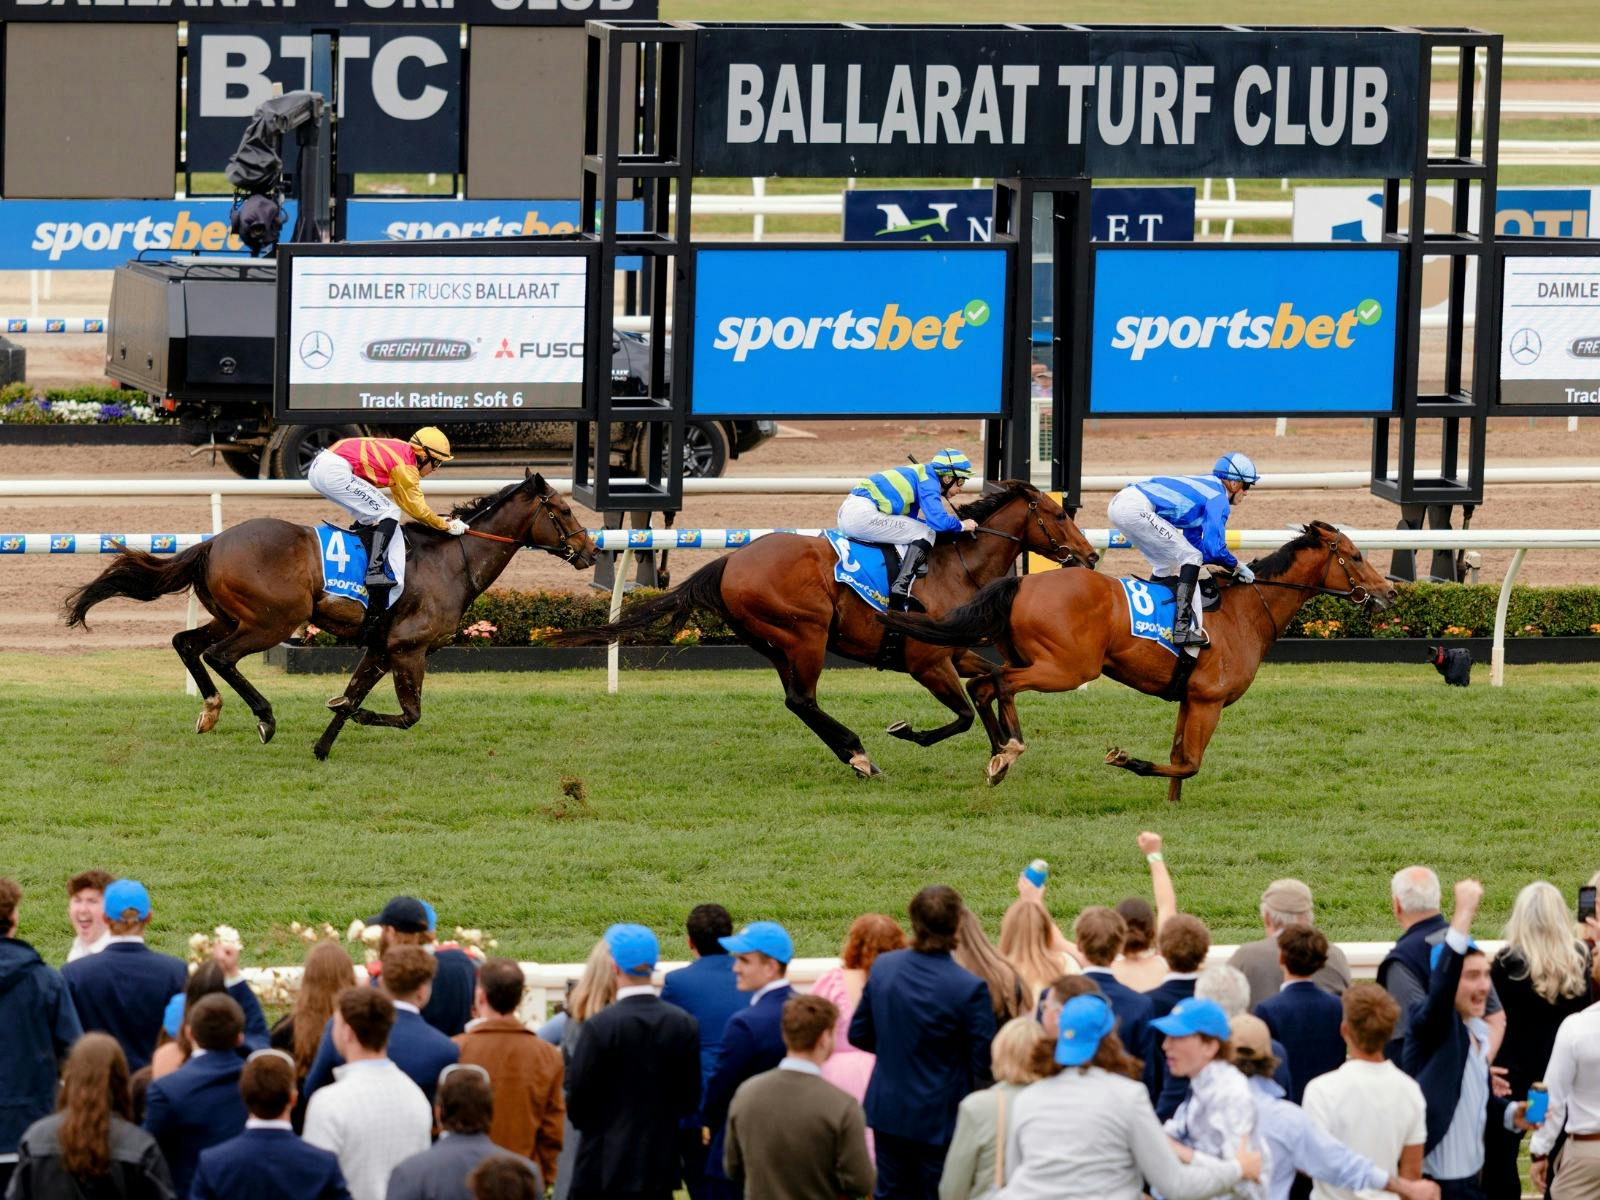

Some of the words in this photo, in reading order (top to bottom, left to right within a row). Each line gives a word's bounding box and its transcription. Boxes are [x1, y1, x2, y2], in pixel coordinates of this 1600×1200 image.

[200, 35, 448, 121] BTC
[727, 63, 1040, 145] BALLARAT
[1058, 65, 1215, 146] TURF
[1234, 64, 1389, 146] CLUB
[386, 211, 580, 241] sportsb
[328, 283, 406, 300] DAIMLER
[408, 283, 473, 300] TRUCKS
[475, 283, 561, 300] BALLARAT
[1538, 282, 1599, 299] DAIMLE
[712, 303, 966, 363] sportsbet
[1110, 302, 1360, 361] sportsbet
[370, 342, 468, 358] FREIGHTLINER
[359, 392, 404, 409] Track
[409, 392, 470, 409] Rating:
[473, 391, 508, 409] Soft
[512, 391, 524, 408] 6
[1564, 387, 1600, 404] Trac
[325, 530, 351, 574] 4
[1126, 579, 1155, 617] 8
